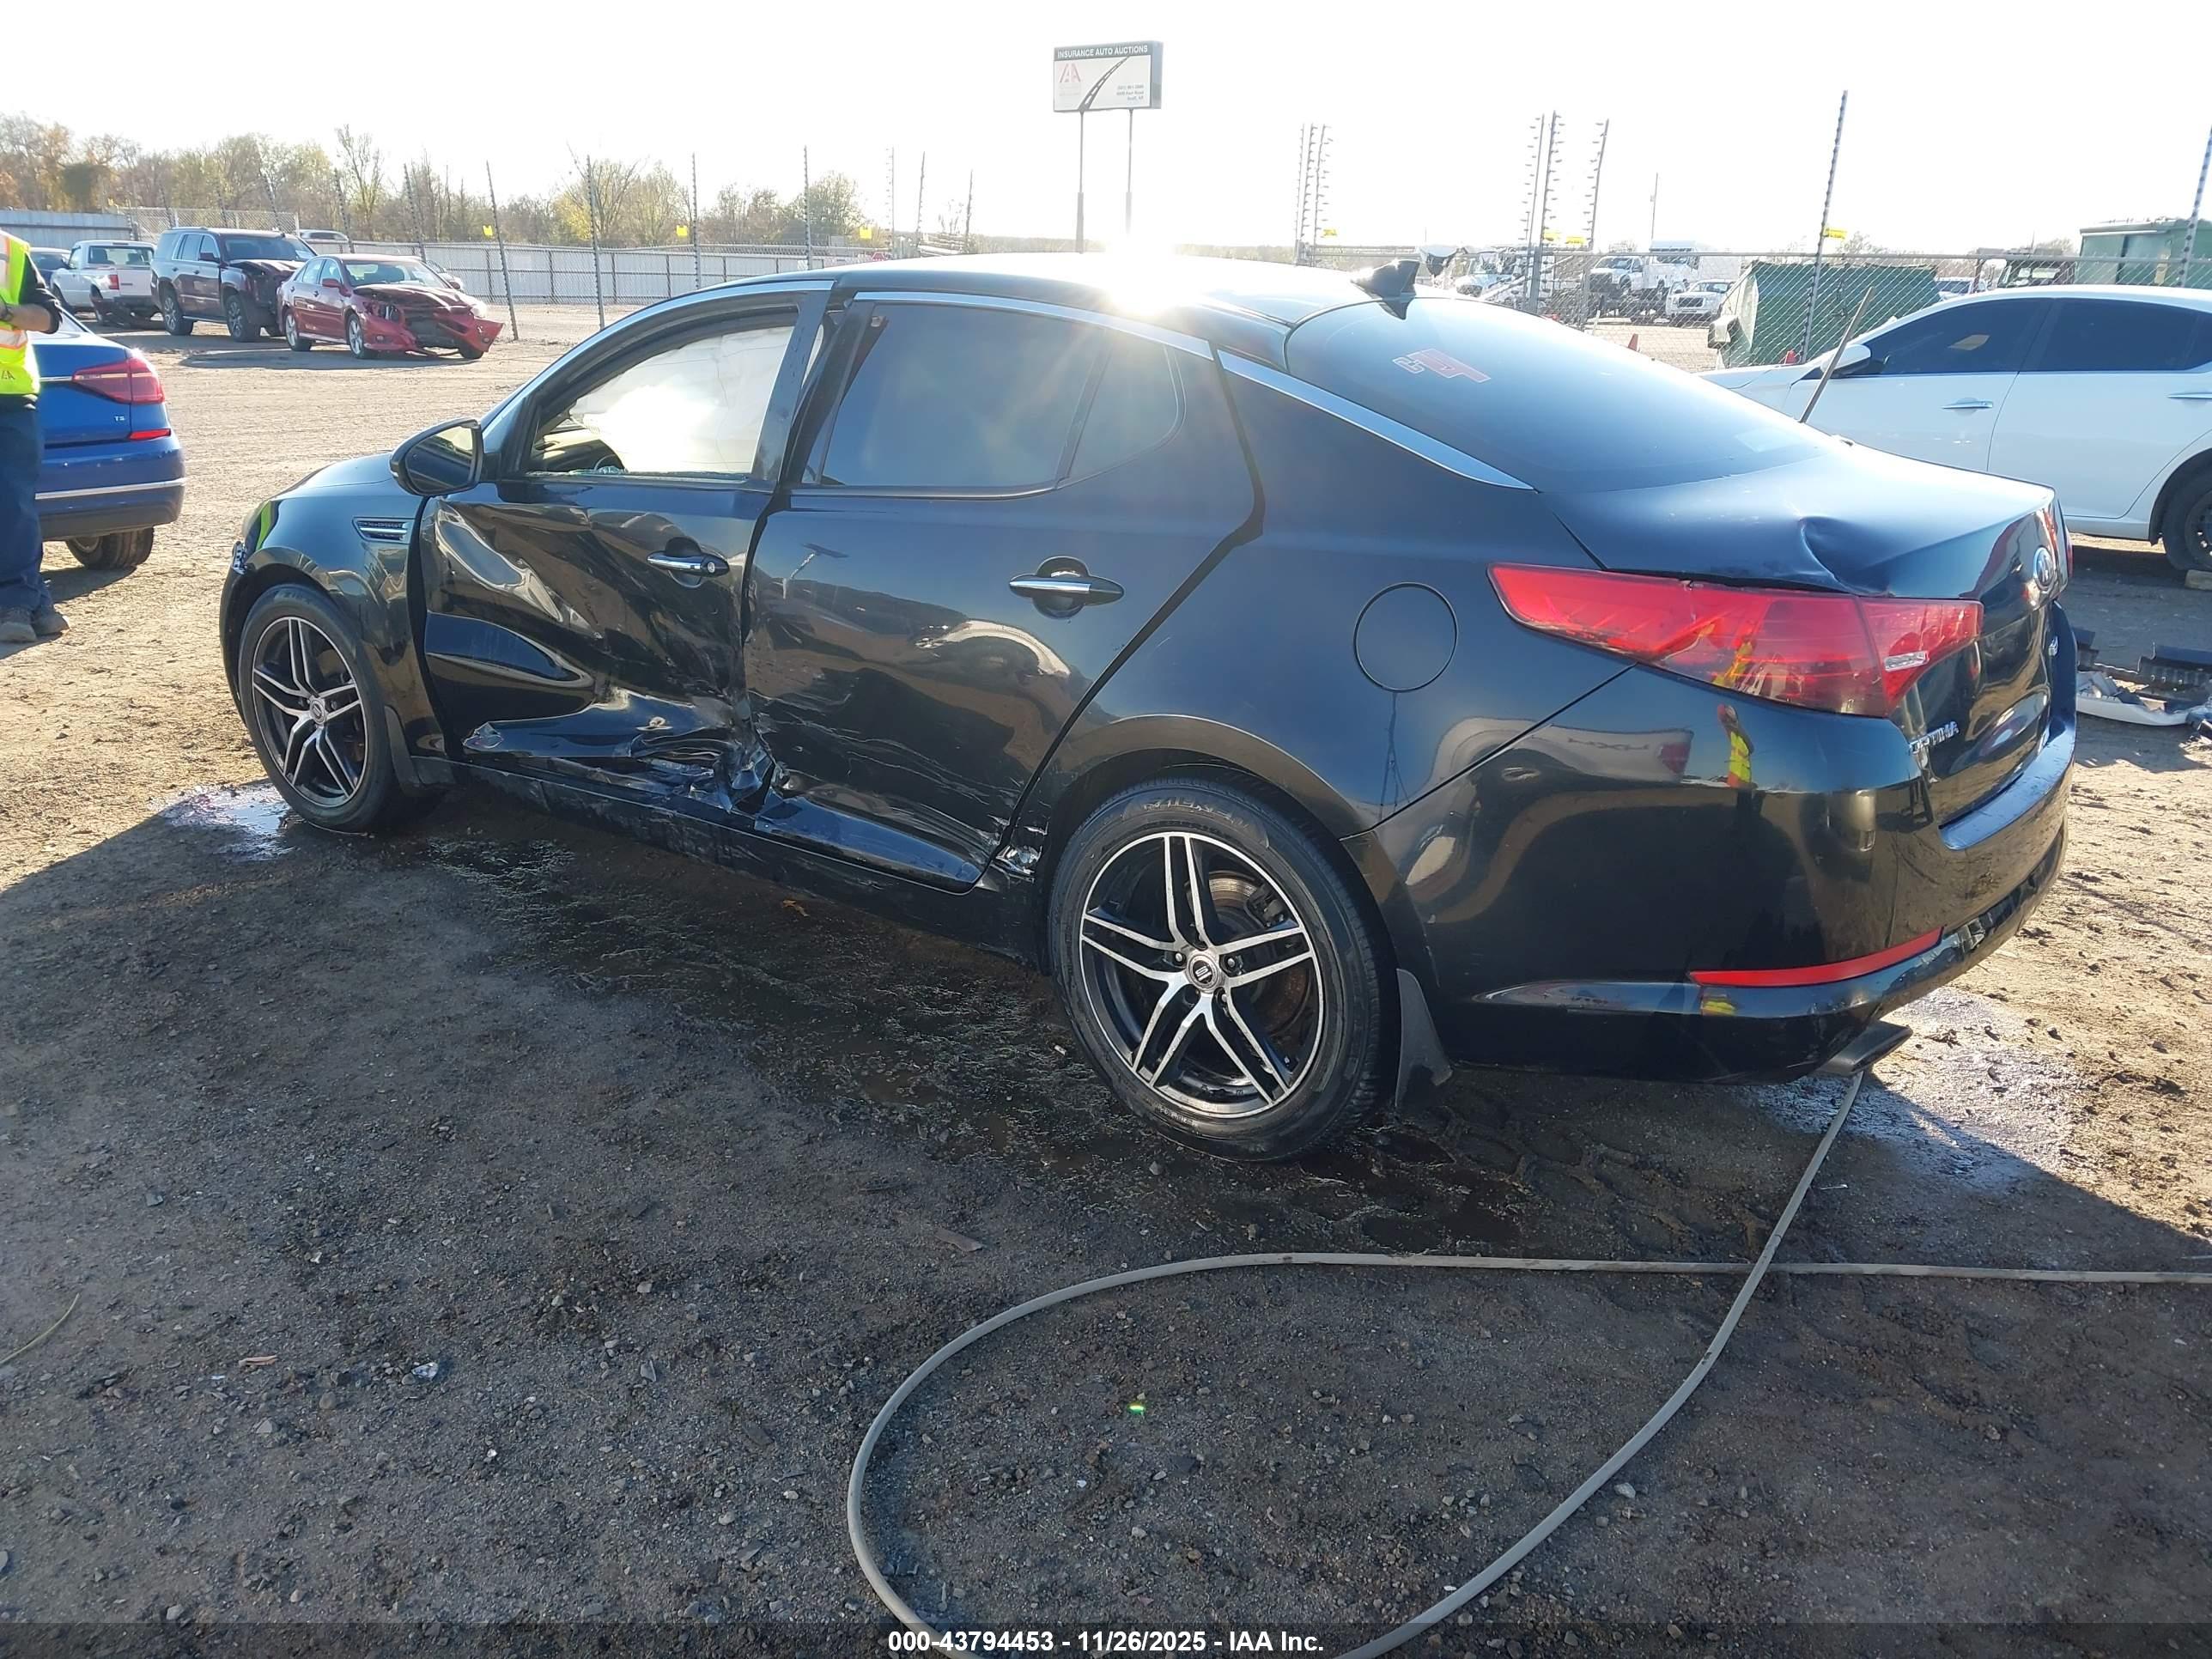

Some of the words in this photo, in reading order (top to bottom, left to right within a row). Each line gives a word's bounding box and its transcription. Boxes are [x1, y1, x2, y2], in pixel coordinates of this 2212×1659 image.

[1057, 48, 1094, 58] INSURANCE
[1096, 47, 1113, 56] AUTO
[1115, 45, 1148, 55] AUCTIONS
